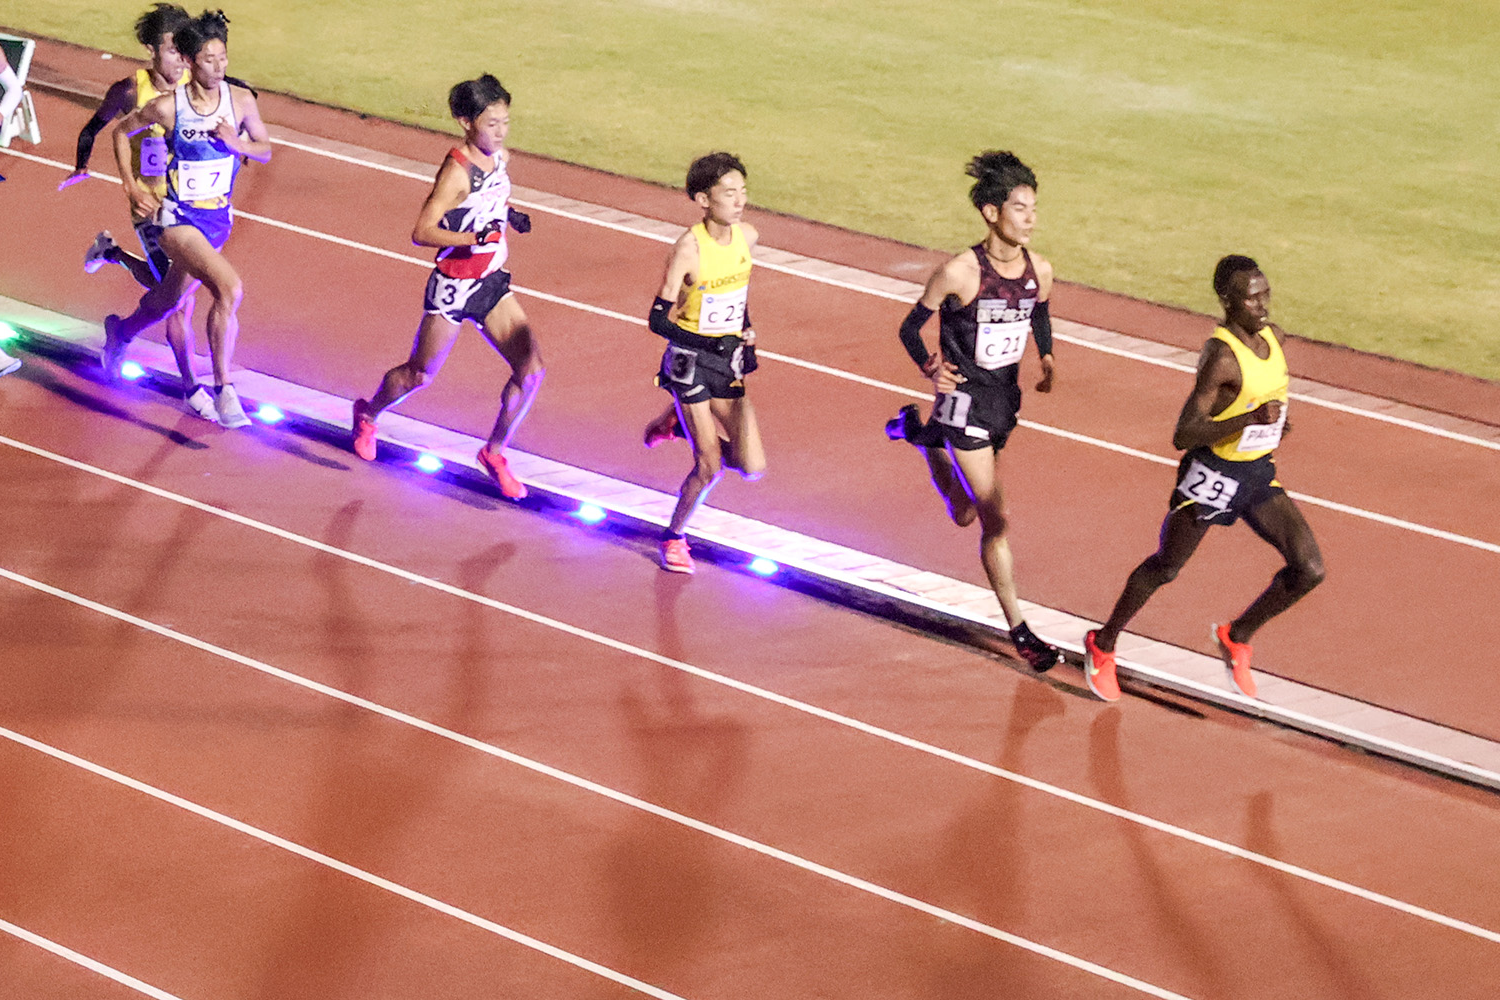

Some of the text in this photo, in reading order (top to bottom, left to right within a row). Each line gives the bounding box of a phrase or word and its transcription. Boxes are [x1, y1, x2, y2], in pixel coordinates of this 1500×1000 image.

[186, 171, 221, 190] C 7
[724, 301, 746, 323] 23
[1000, 336, 1021, 356] 21
[1188, 471, 1225, 501] 29
